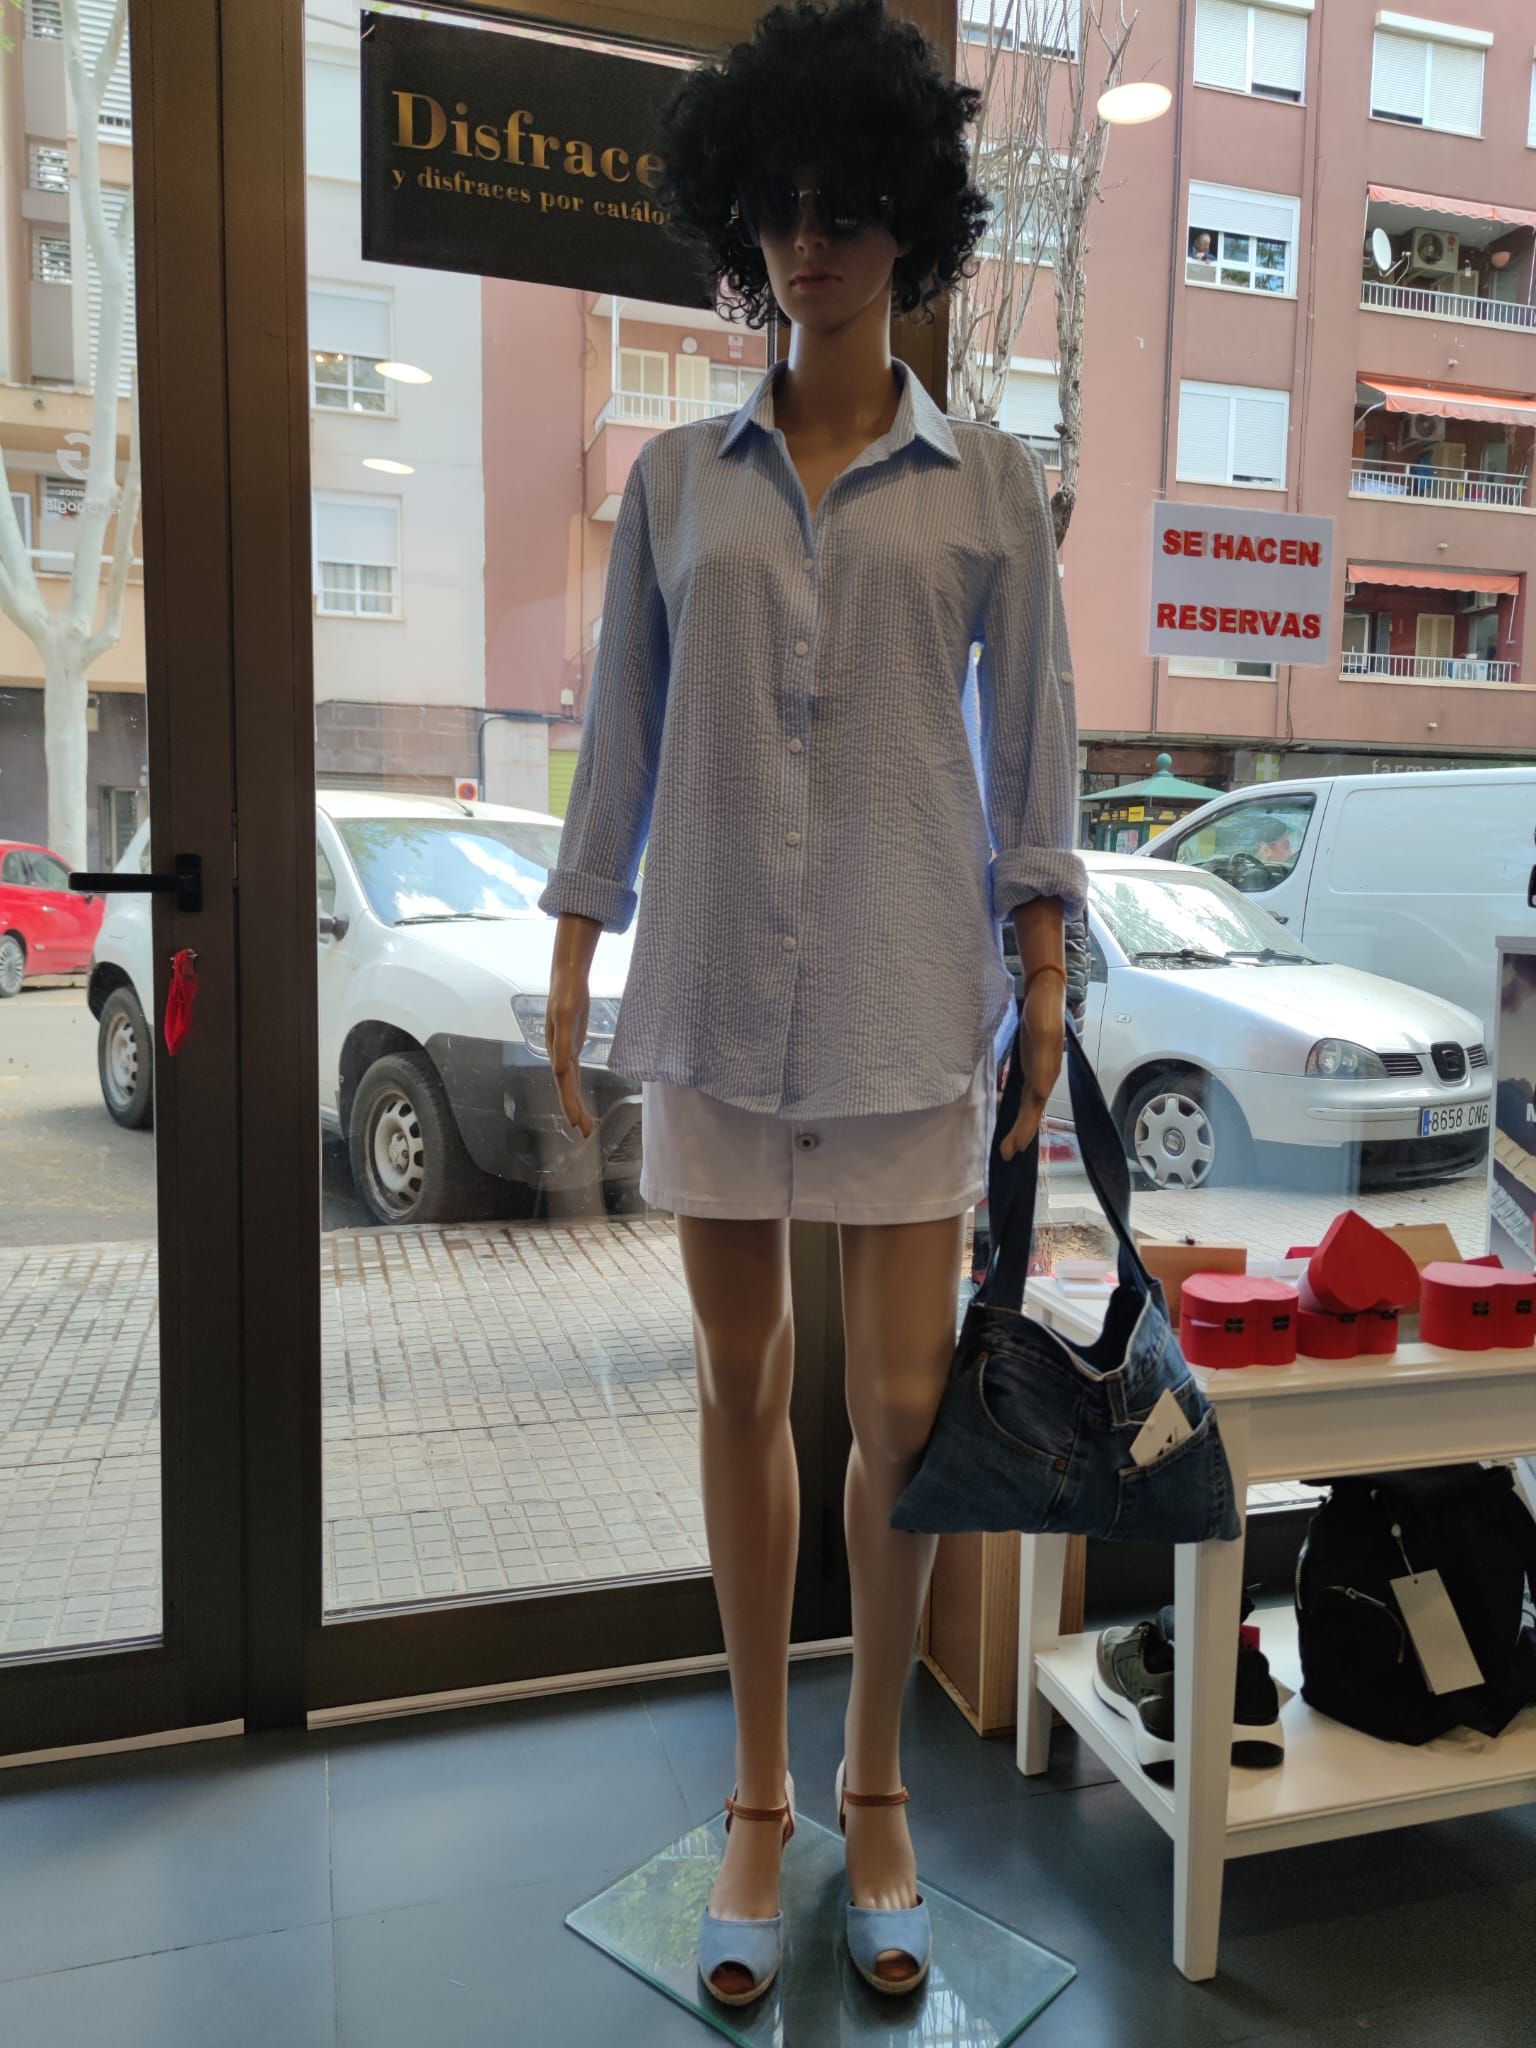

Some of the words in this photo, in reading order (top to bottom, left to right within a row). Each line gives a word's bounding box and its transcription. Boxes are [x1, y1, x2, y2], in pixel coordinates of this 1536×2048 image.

[392, 90, 667, 189] Disfrace
[392, 168, 405, 190] y
[416, 166, 532, 204] disfraces
[539, 190, 585, 213] por
[593, 200, 672, 226] catálo
[1162, 529, 1204, 557] SE
[1213, 533, 1322, 568] HACEN
[1157, 603, 1321, 639] RESERVAS
[1432, 1108, 1463, 1131] 8658
